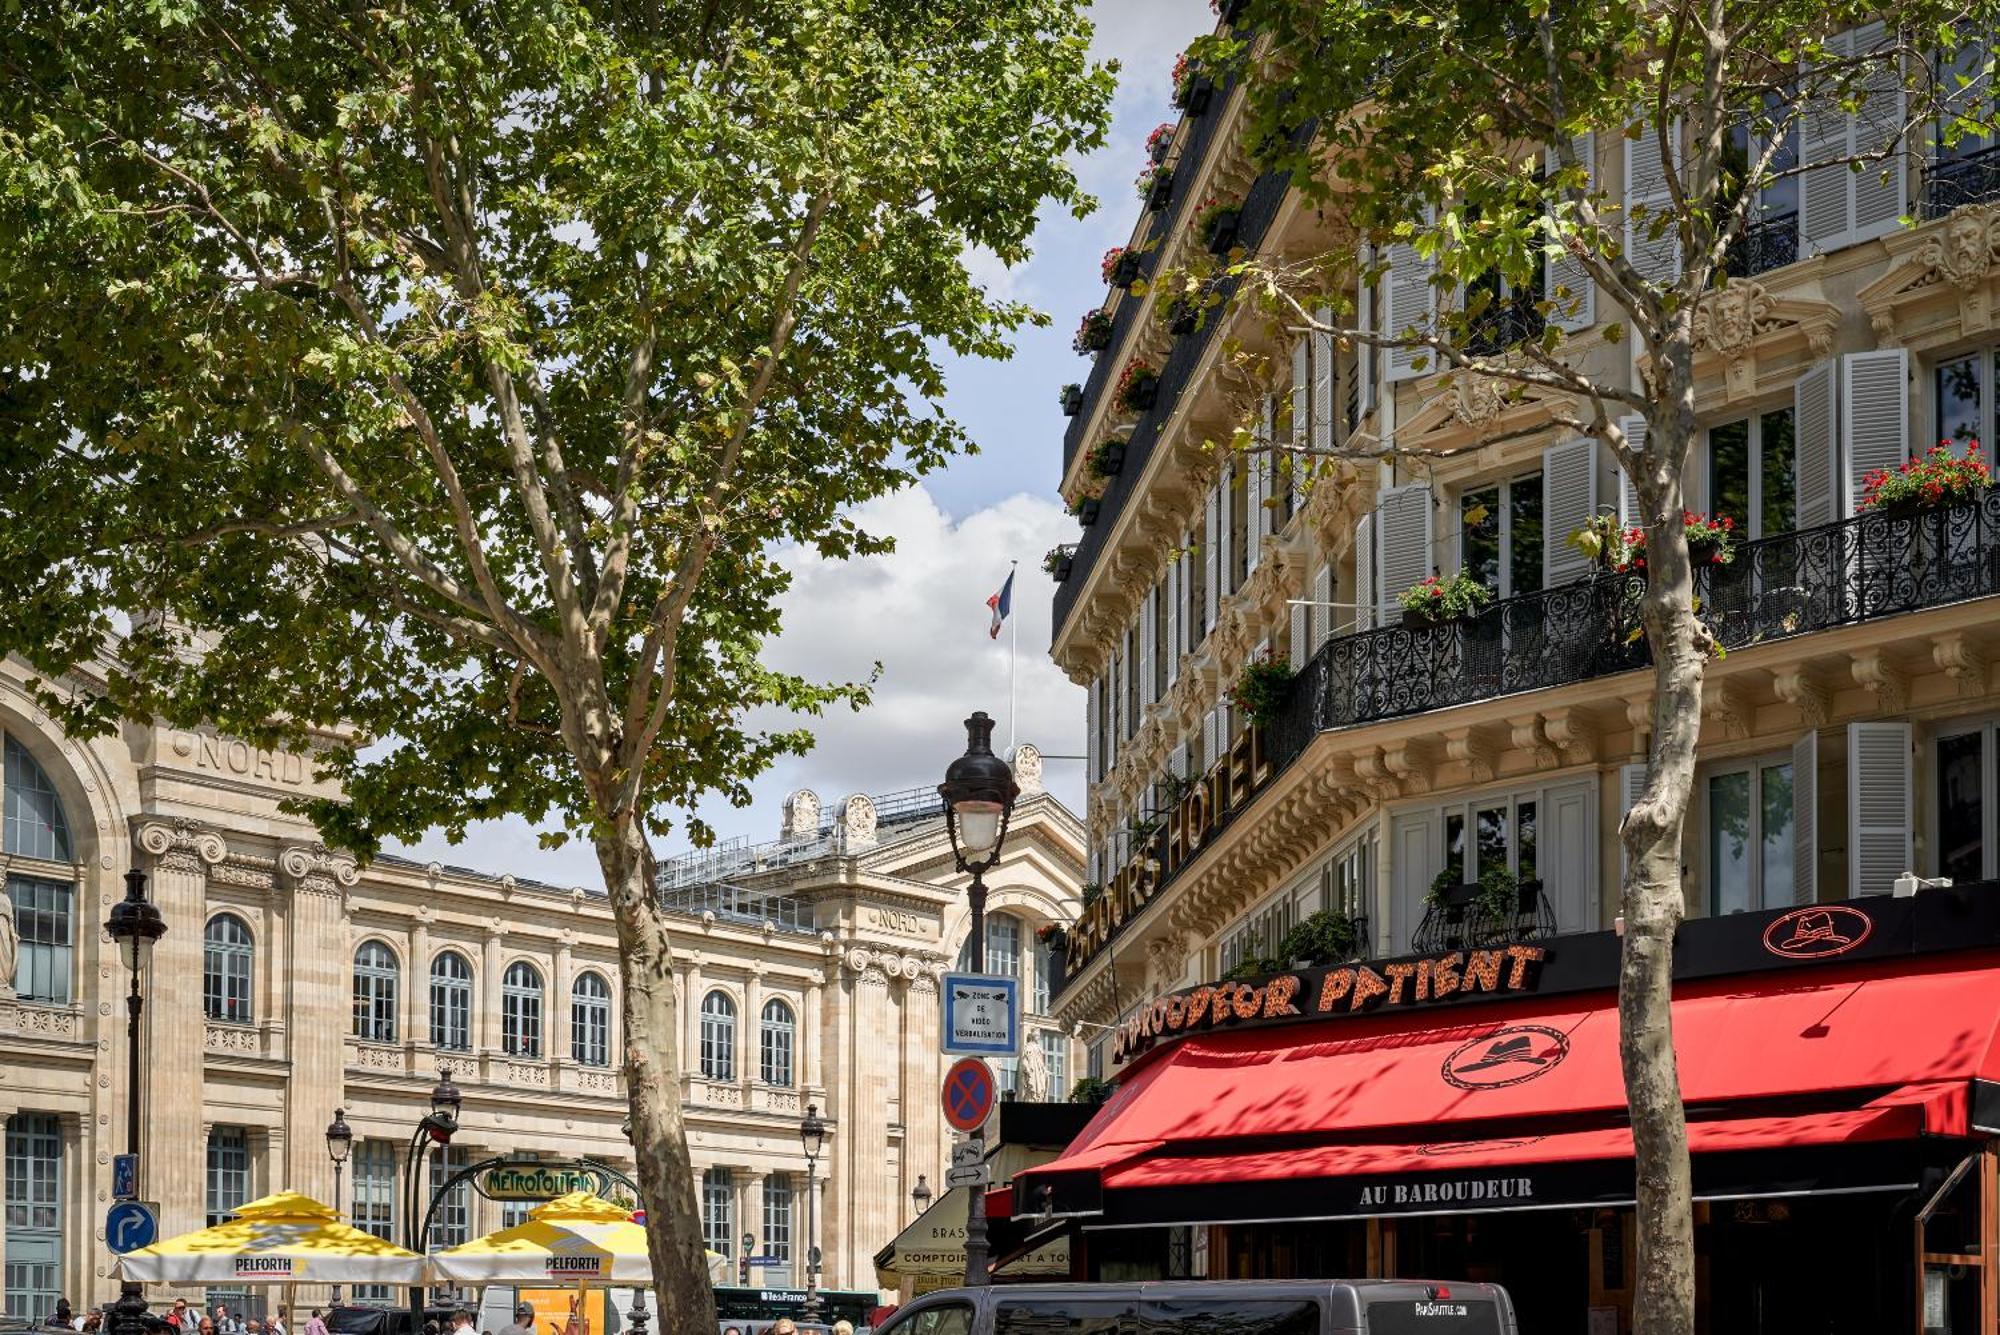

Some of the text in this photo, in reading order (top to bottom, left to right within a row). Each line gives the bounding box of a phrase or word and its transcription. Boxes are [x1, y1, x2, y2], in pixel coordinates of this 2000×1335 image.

[197, 732, 303, 785] NORD
[1168, 724, 1272, 873] HOTEL
[879, 908, 917, 933] NORD
[1318, 944, 1546, 1012] PATIENT
[972, 992, 990, 1000] ZONE
[956, 1029, 1006, 1039] VERBALISATION
[1359, 1178, 1533, 1205] AU BAROUDEUR
[932, 1228, 967, 1238] BRAS
[235, 1258, 292, 1271] PELFORTH
[545, 1257, 600, 1270] PELFORTH
[1051, 1254, 1069, 1263] TO
